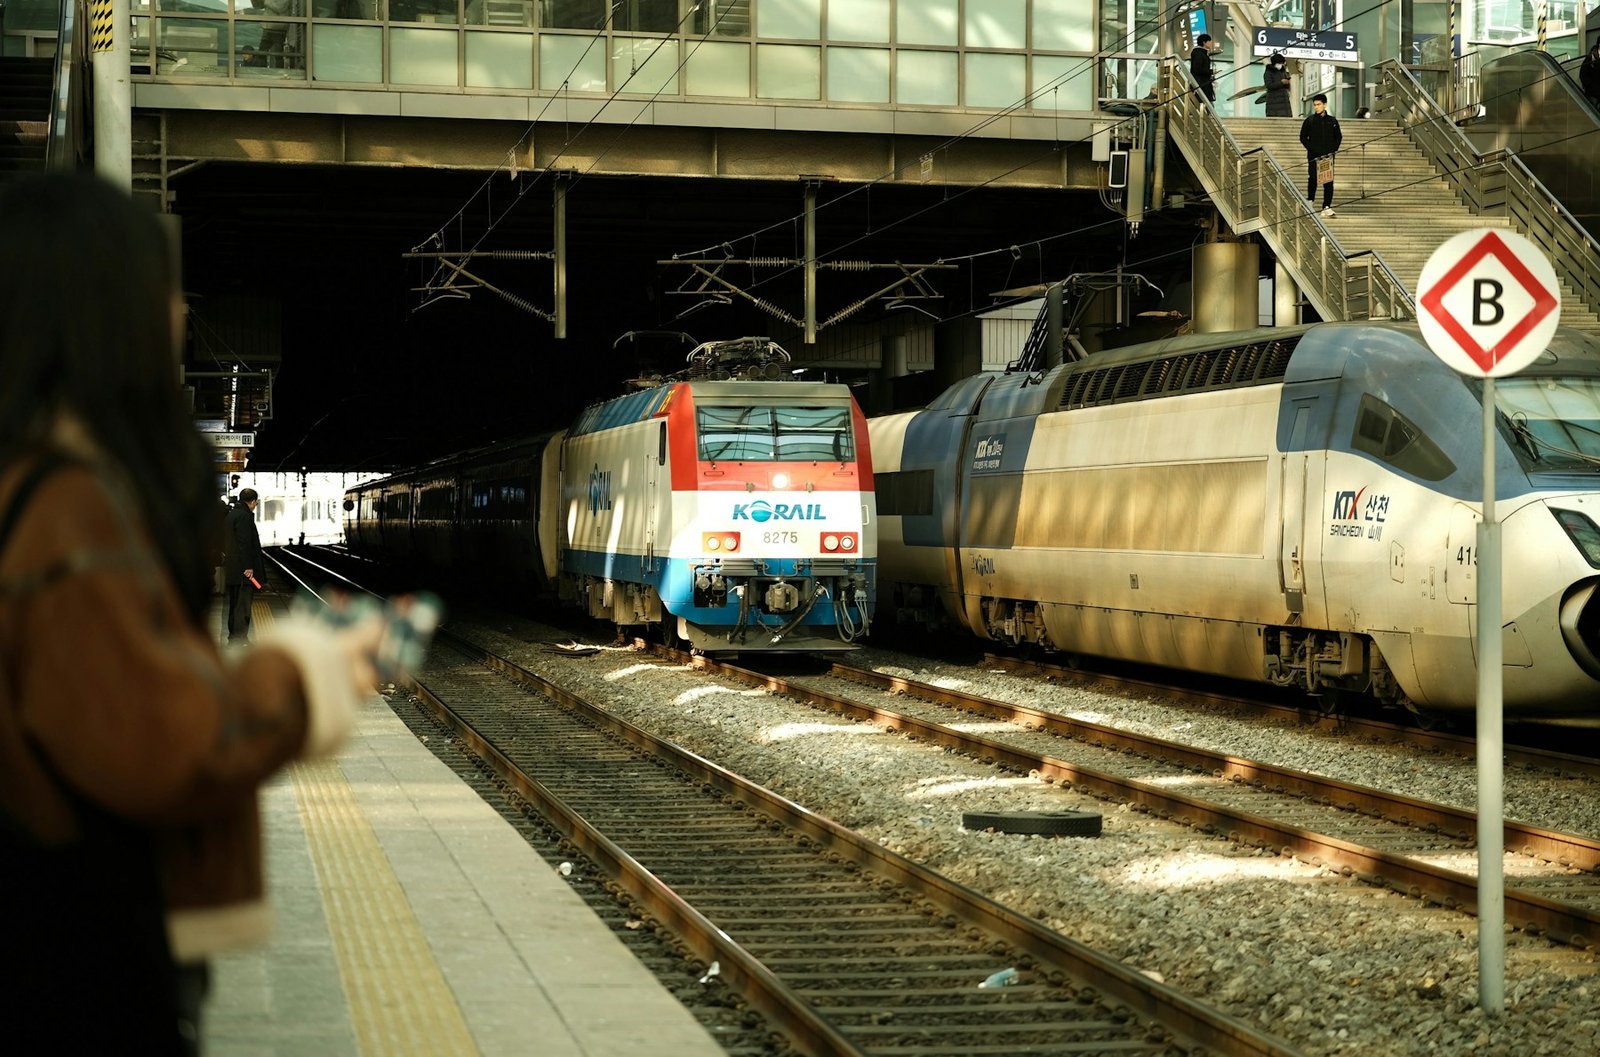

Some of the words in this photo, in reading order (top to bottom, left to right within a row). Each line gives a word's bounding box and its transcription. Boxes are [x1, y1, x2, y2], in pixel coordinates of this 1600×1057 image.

[1257, 29, 1267, 44] 6
[1345, 35, 1354, 49] 5
[1472, 278, 1504, 326] B
[587, 463, 612, 517] KORAIL
[732, 500, 826, 523] KORAIL
[1332, 485, 1368, 520] KTX
[1364, 494, 1390, 523] 산천
[763, 531, 798, 544] 8275
[1330, 524, 1364, 538] SANCHEON
[1367, 524, 1383, 542] 山川
